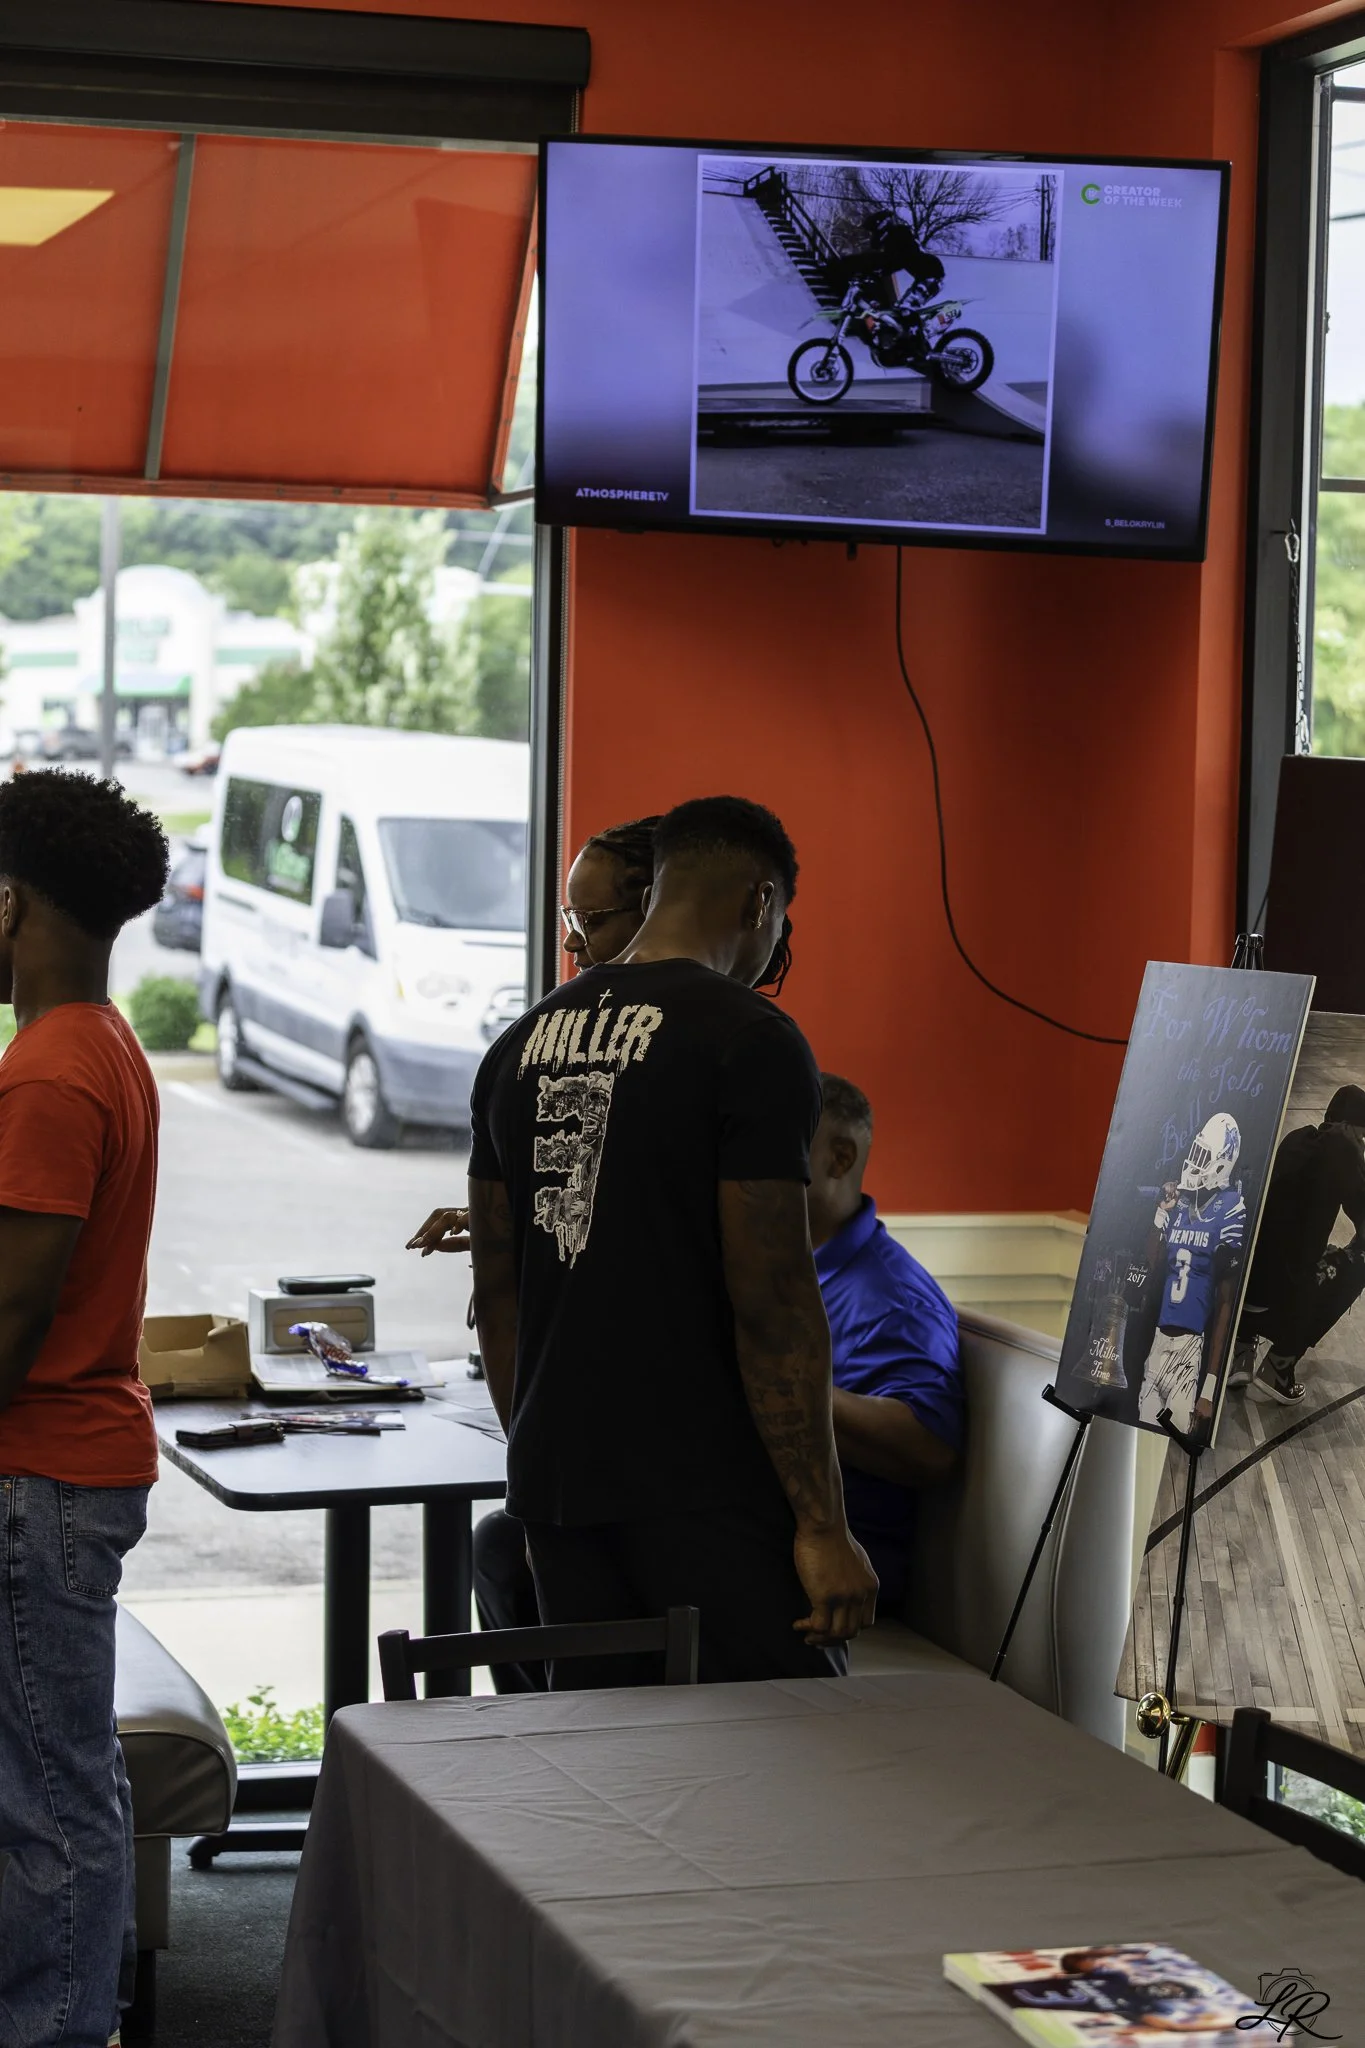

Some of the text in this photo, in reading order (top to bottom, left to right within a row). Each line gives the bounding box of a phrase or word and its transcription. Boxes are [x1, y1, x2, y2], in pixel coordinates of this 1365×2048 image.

[1104, 185, 1161, 197] CREATOR
[1104, 195, 1183, 208] OF THE WEEK
[1144, 984, 1294, 1054] For Whom
[517, 1003, 663, 1081] MILLER
[1177, 1056, 1204, 1083] the
[1154, 1091, 1202, 1170] Bell
[1169, 1229, 1210, 1248] MEMPHIS
[1127, 1272, 1147, 1288] 2017
[1170, 1248, 1192, 1304] 3
[1089, 1337, 1120, 1361] Miller
[1090, 1360, 1110, 1381] Time
